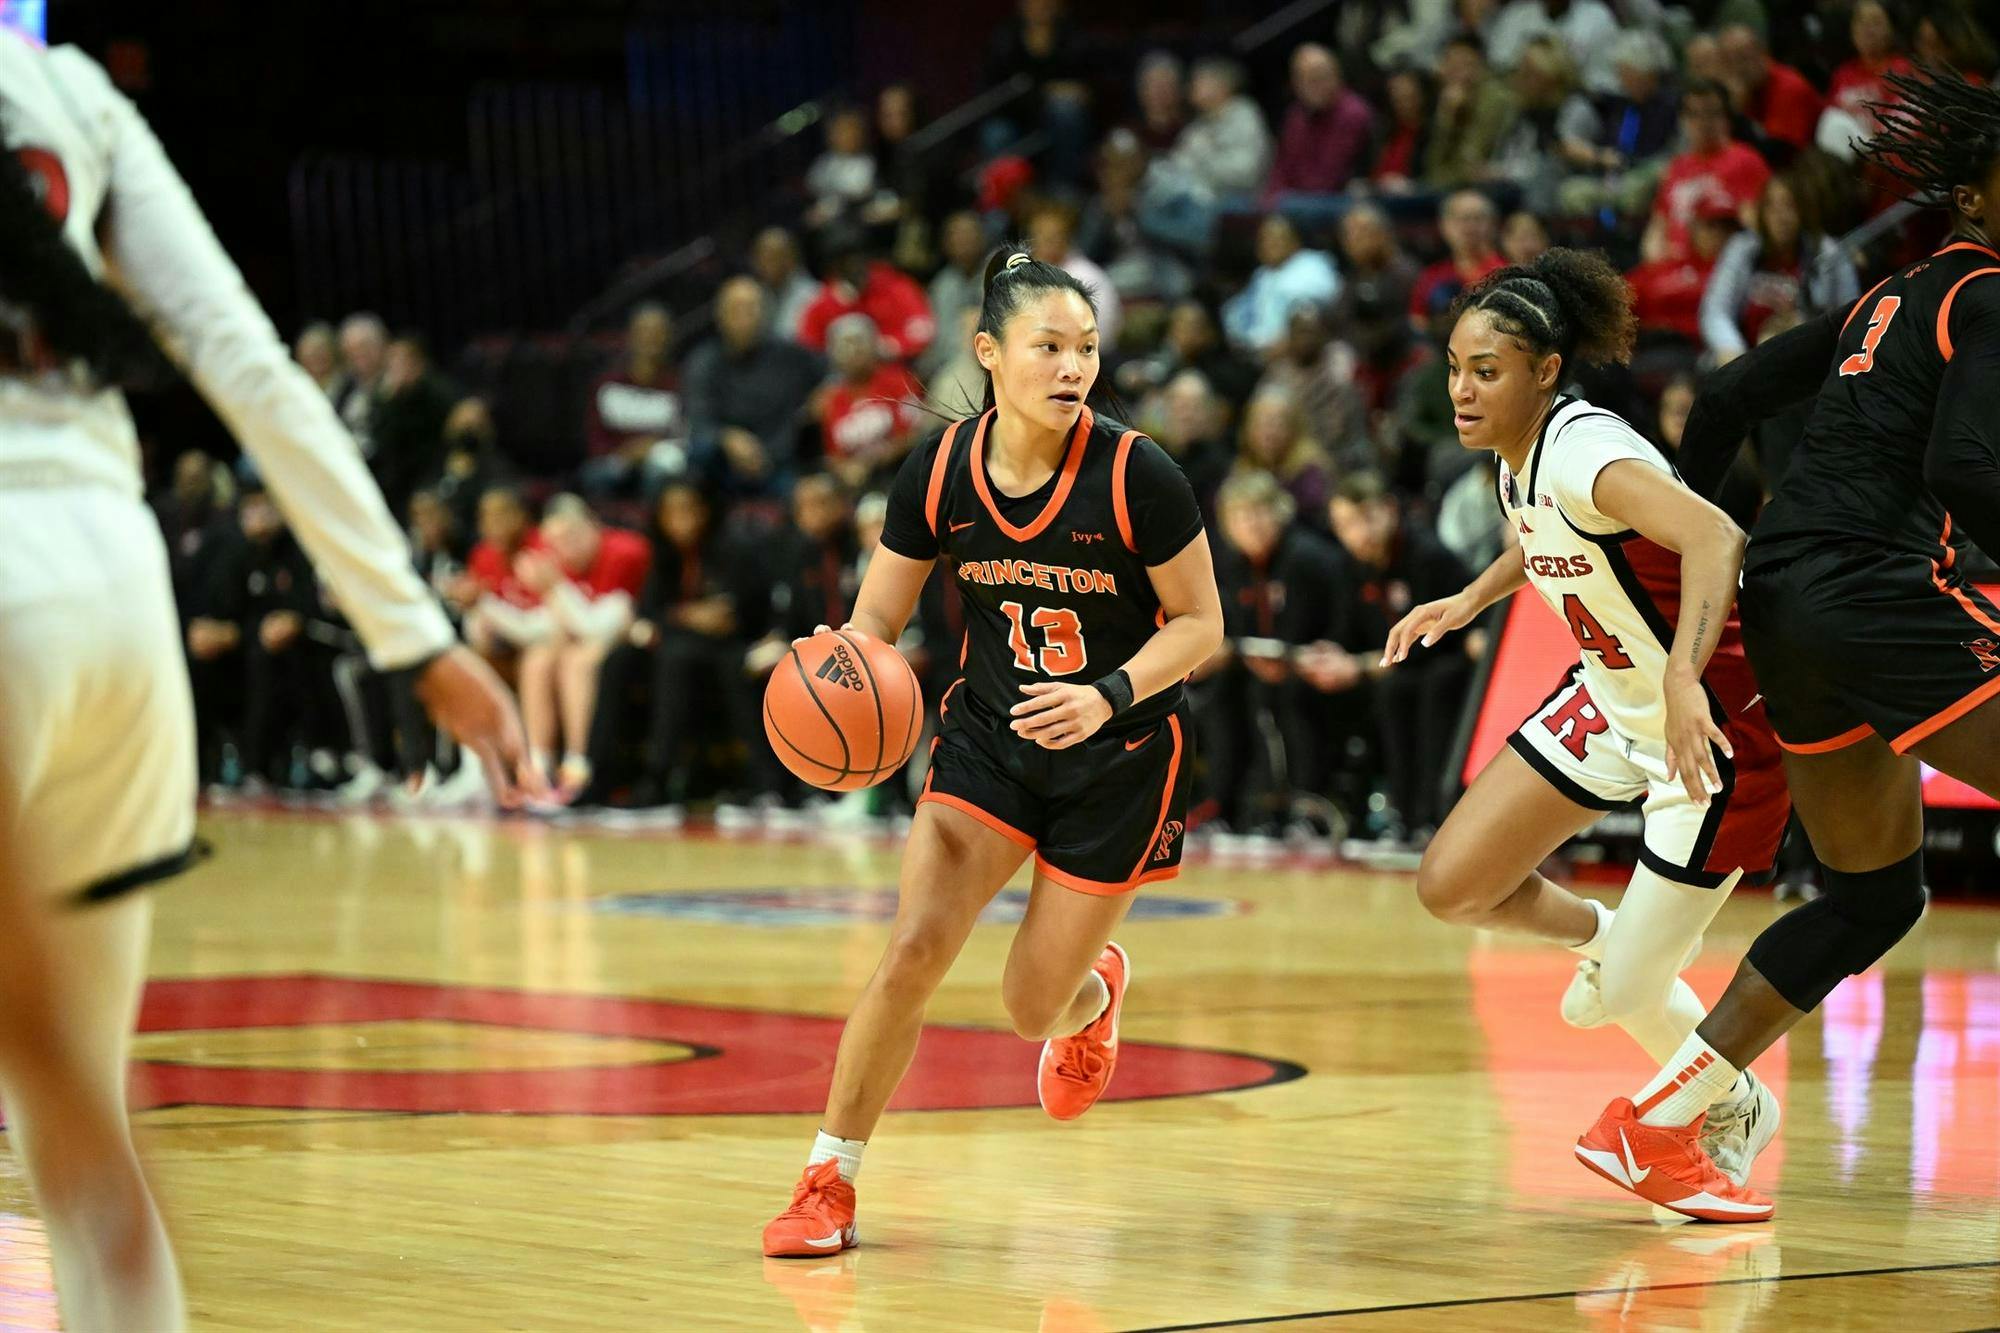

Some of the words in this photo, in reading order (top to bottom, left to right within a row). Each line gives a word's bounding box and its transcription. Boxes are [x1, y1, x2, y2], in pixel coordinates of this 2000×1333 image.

[1839, 295, 1901, 376] 3
[1071, 531, 1093, 545] Ivy
[958, 559, 1118, 596] PRINCETON
[834, 644, 864, 692] adidas
[1000, 600, 1088, 677] 13
[1562, 593, 1636, 670] 4
[1540, 682, 1610, 763] R
